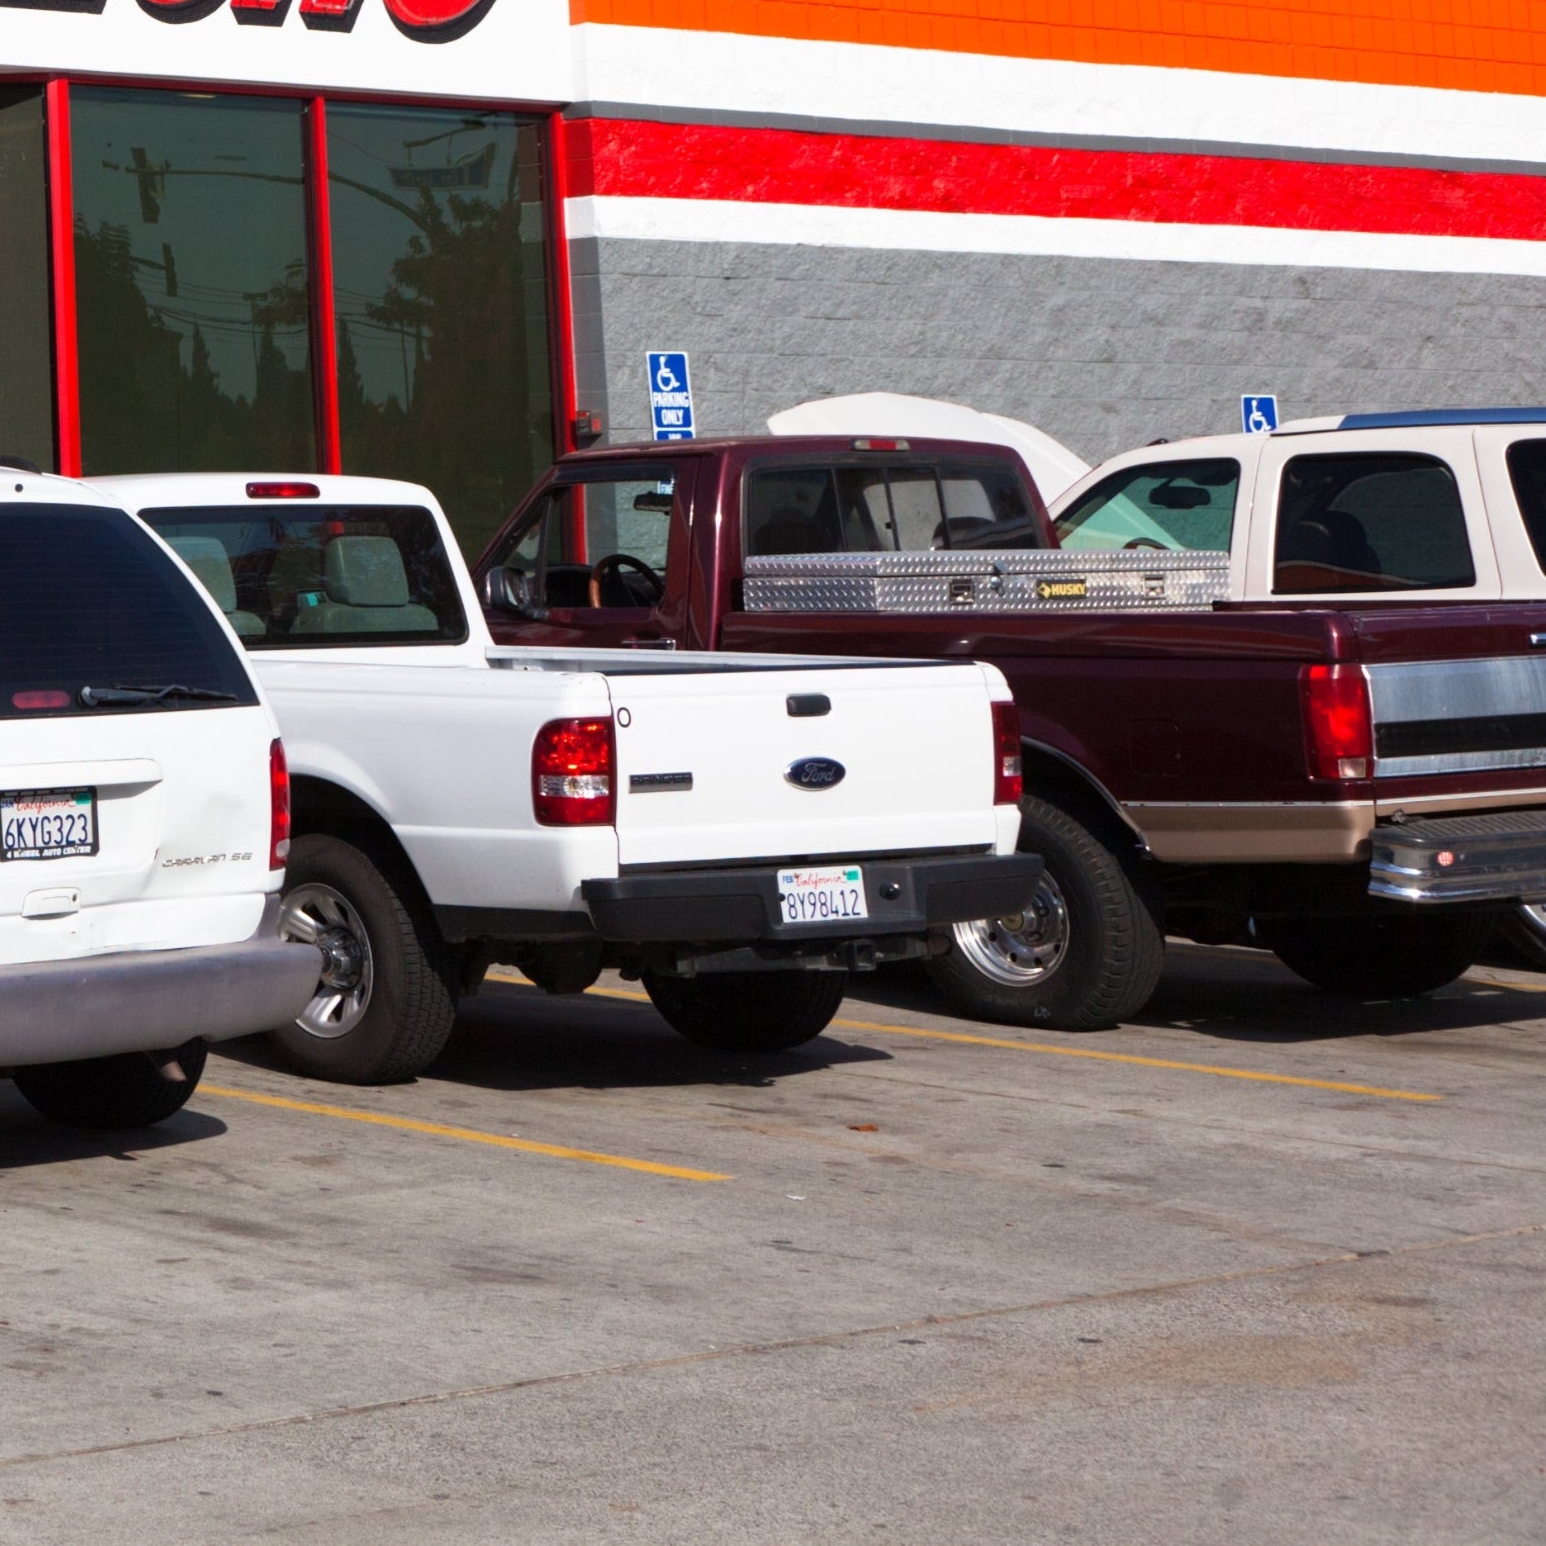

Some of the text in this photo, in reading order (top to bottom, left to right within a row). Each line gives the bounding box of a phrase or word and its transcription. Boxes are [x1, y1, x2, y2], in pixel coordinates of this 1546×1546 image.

[653, 392, 689, 407] PARKING
[661, 409, 684, 425] ONLY
[1051, 583, 1085, 595] HUSKY
[801, 762, 835, 783] Ford
[15, 795, 76, 814] California
[5, 813, 88, 849] 6KYG323
[14, 849, 40, 858] WHEEL
[43, 847, 61, 857] AUTO
[63, 845, 92, 855] CENTER
[796, 872, 847, 889] California
[787, 889, 861, 919] 8Y98412
